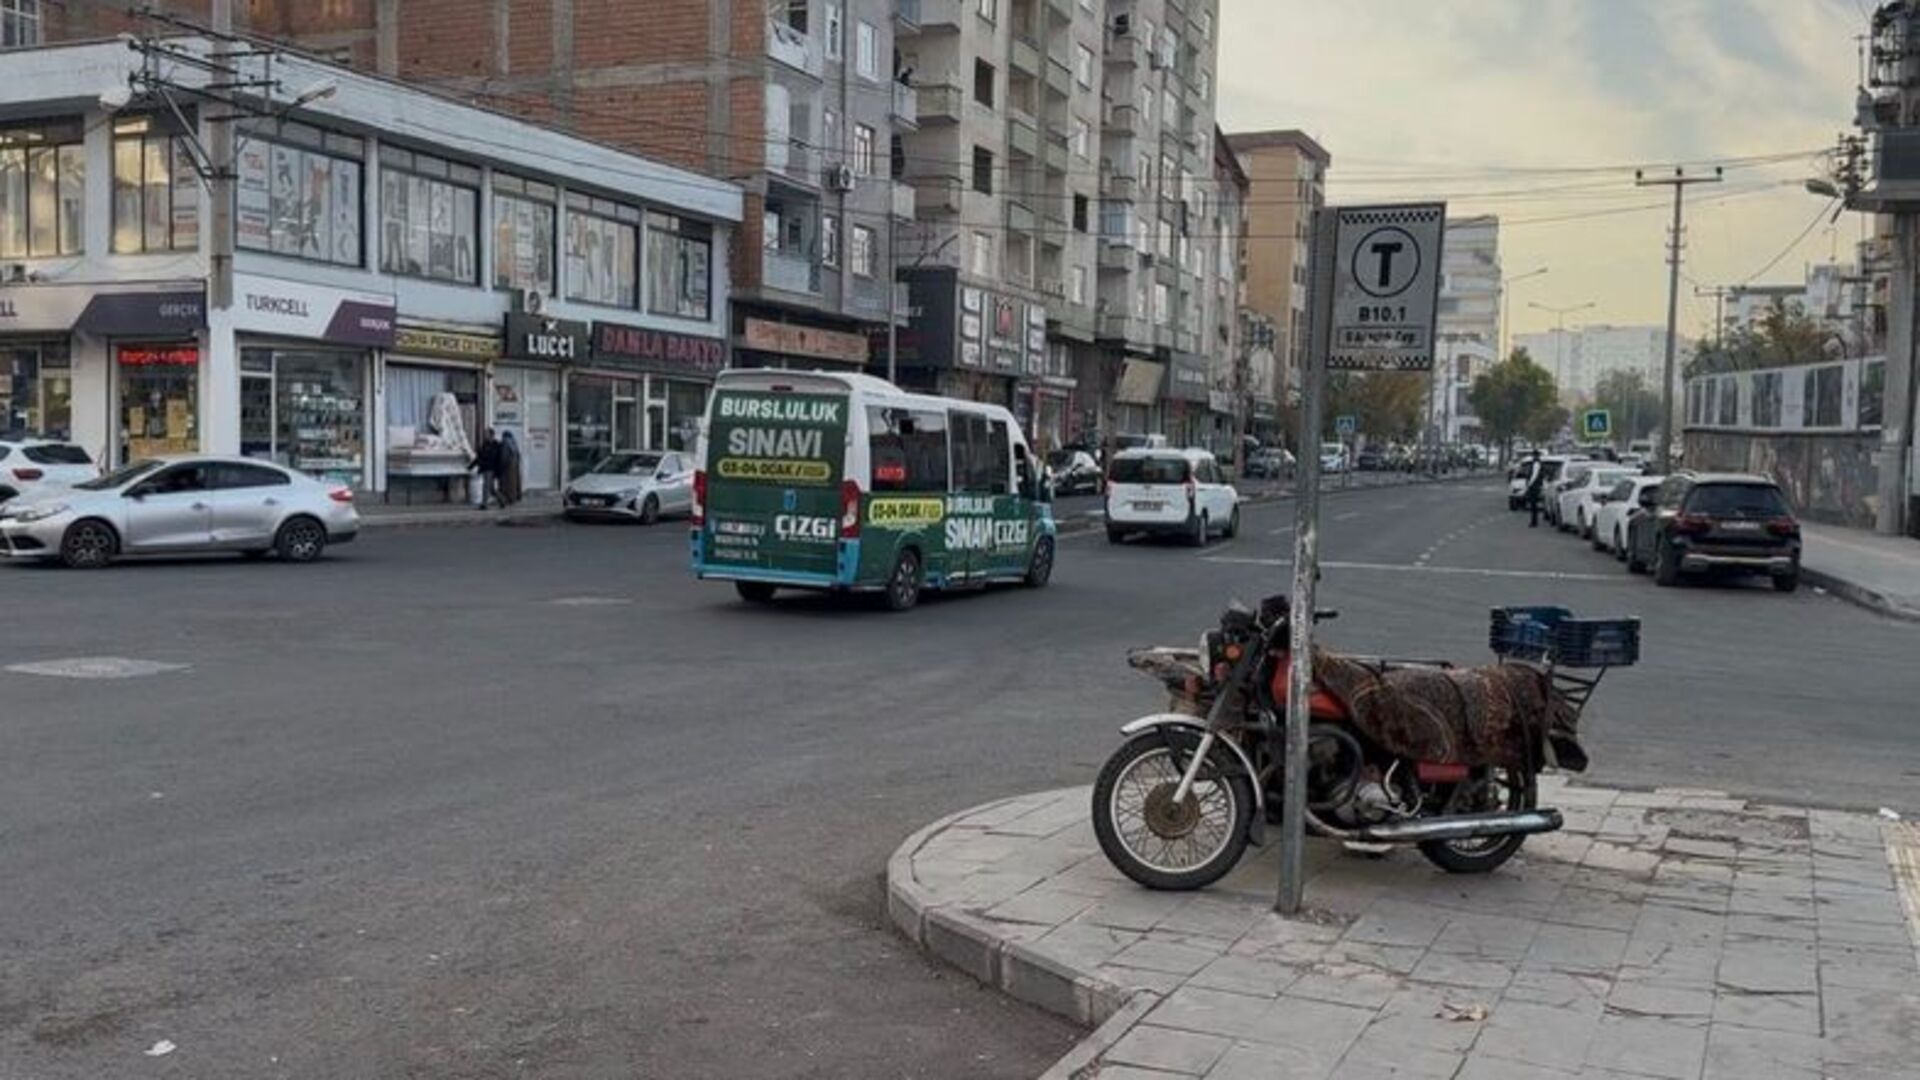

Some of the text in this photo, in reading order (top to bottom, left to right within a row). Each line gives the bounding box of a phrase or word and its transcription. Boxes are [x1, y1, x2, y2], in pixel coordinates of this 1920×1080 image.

[1371, 242, 1403, 287] T
[246, 294, 309, 317] TURKCELL
[1359, 306, 1406, 322] B10.1
[528, 334, 574, 358] LUCCI
[721, 397, 839, 422] BURSLULUK
[728, 427, 823, 458] SINAVI
[759, 463, 794, 476] OCAK
